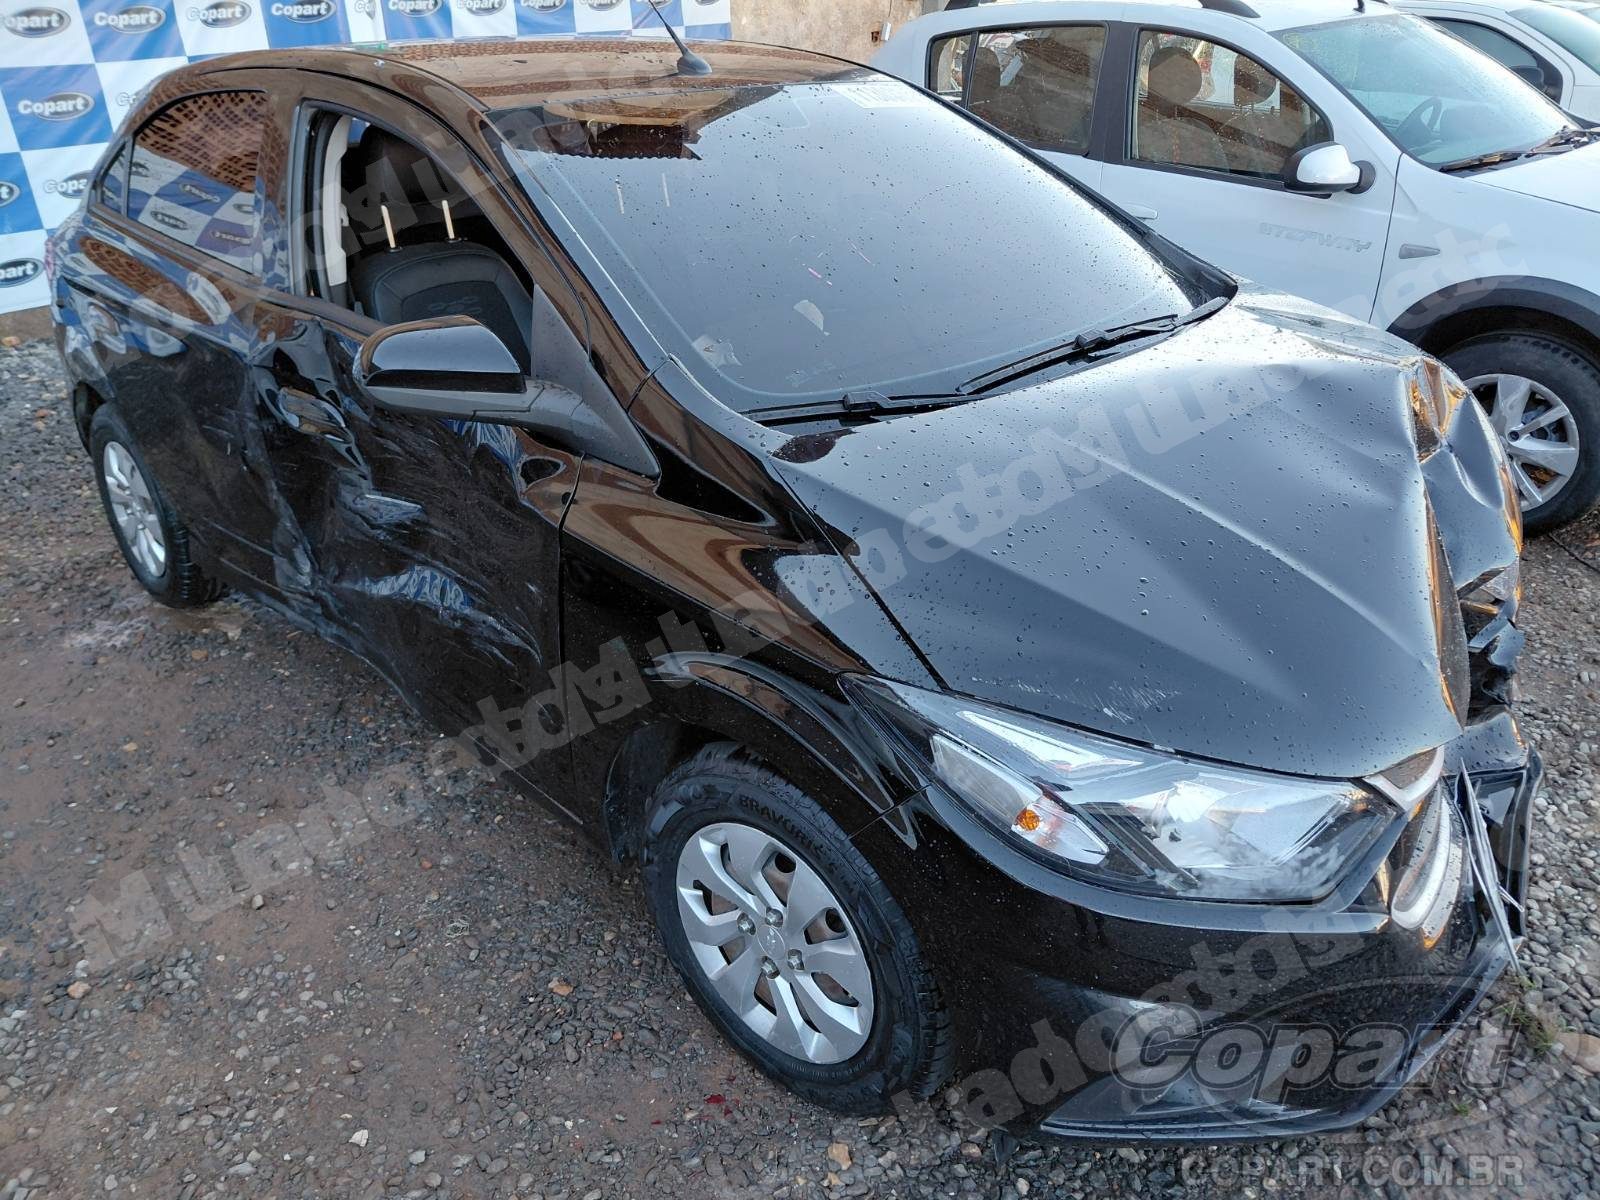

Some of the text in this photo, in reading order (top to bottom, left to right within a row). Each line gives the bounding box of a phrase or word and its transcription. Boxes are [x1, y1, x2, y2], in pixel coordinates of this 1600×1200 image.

[186, 5, 243, 23] Copart
[271, 2, 328, 17] Copart
[388, 0, 434, 13] Copart
[94, 11, 158, 29] Copart
[18, 98, 85, 117] Copart
[44, 179, 88, 194] Copa
